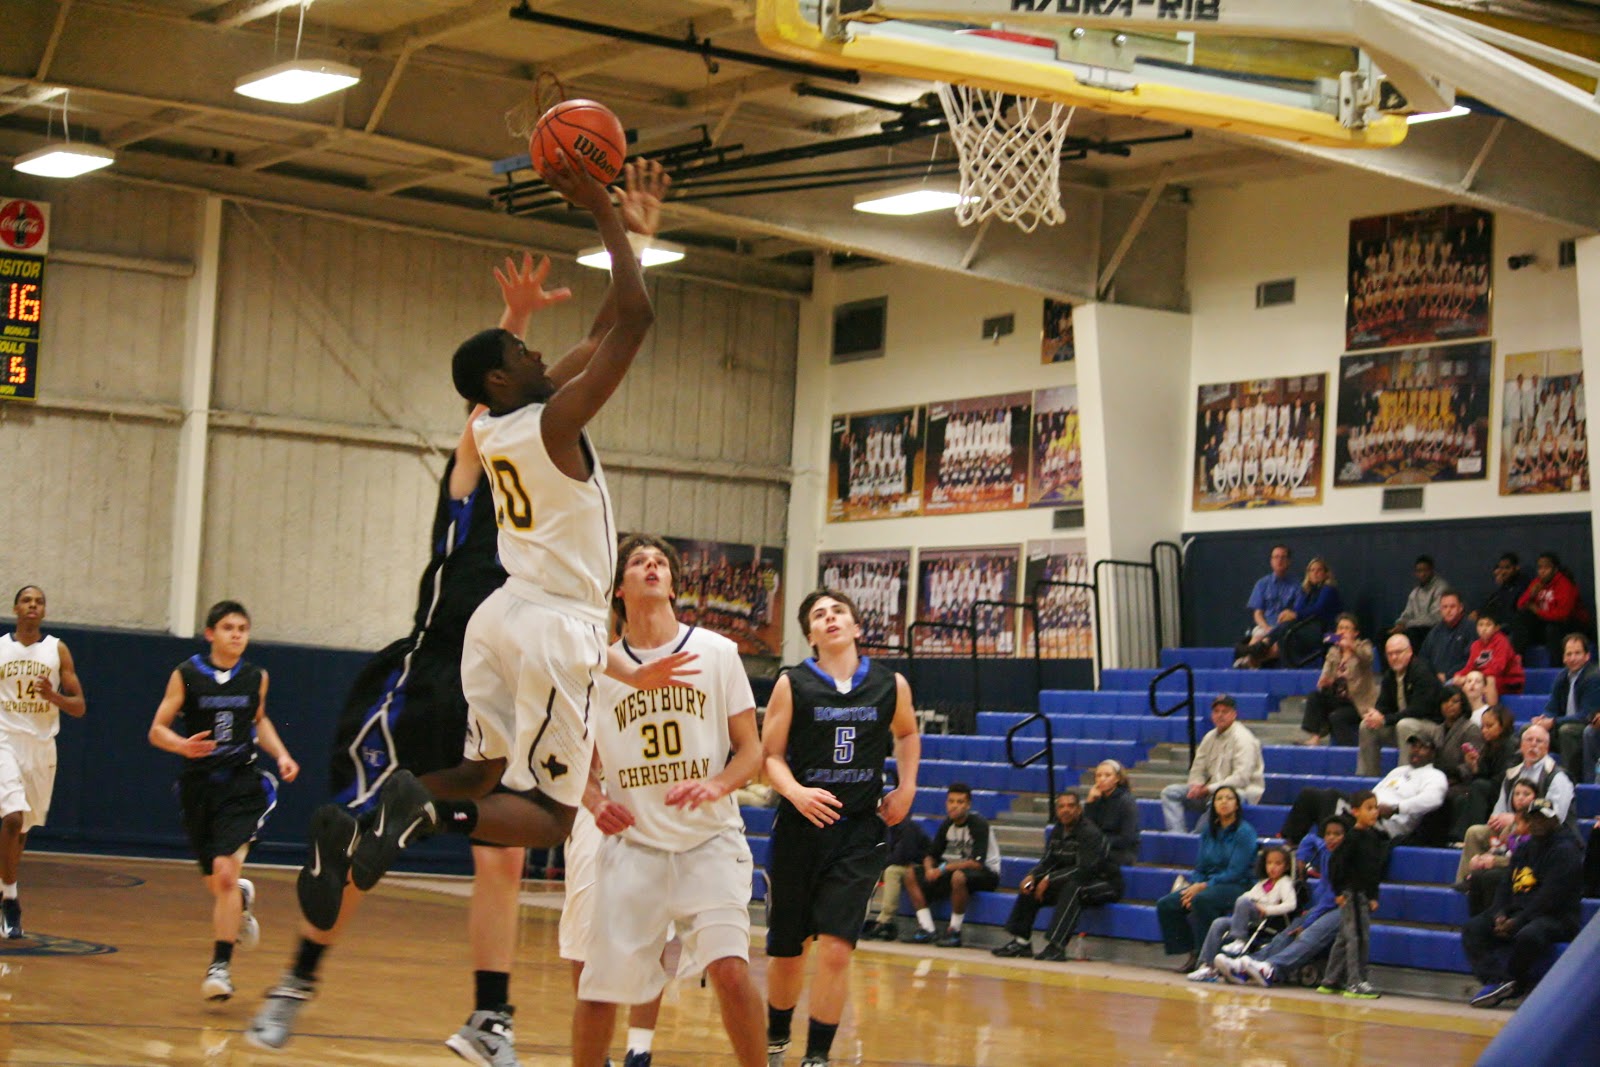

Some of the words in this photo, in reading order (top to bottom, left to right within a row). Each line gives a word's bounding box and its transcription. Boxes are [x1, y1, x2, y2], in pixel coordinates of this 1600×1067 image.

[573, 134, 617, 177] Wilson
[8, 282, 41, 322] 16
[9, 355, 27, 384] 5
[16, 679, 36, 699] 14
[614, 686, 707, 732] WESTBURY
[640, 719, 682, 759] 30
[833, 726, 856, 764] 5
[618, 758, 710, 789] CHRISTIAN
